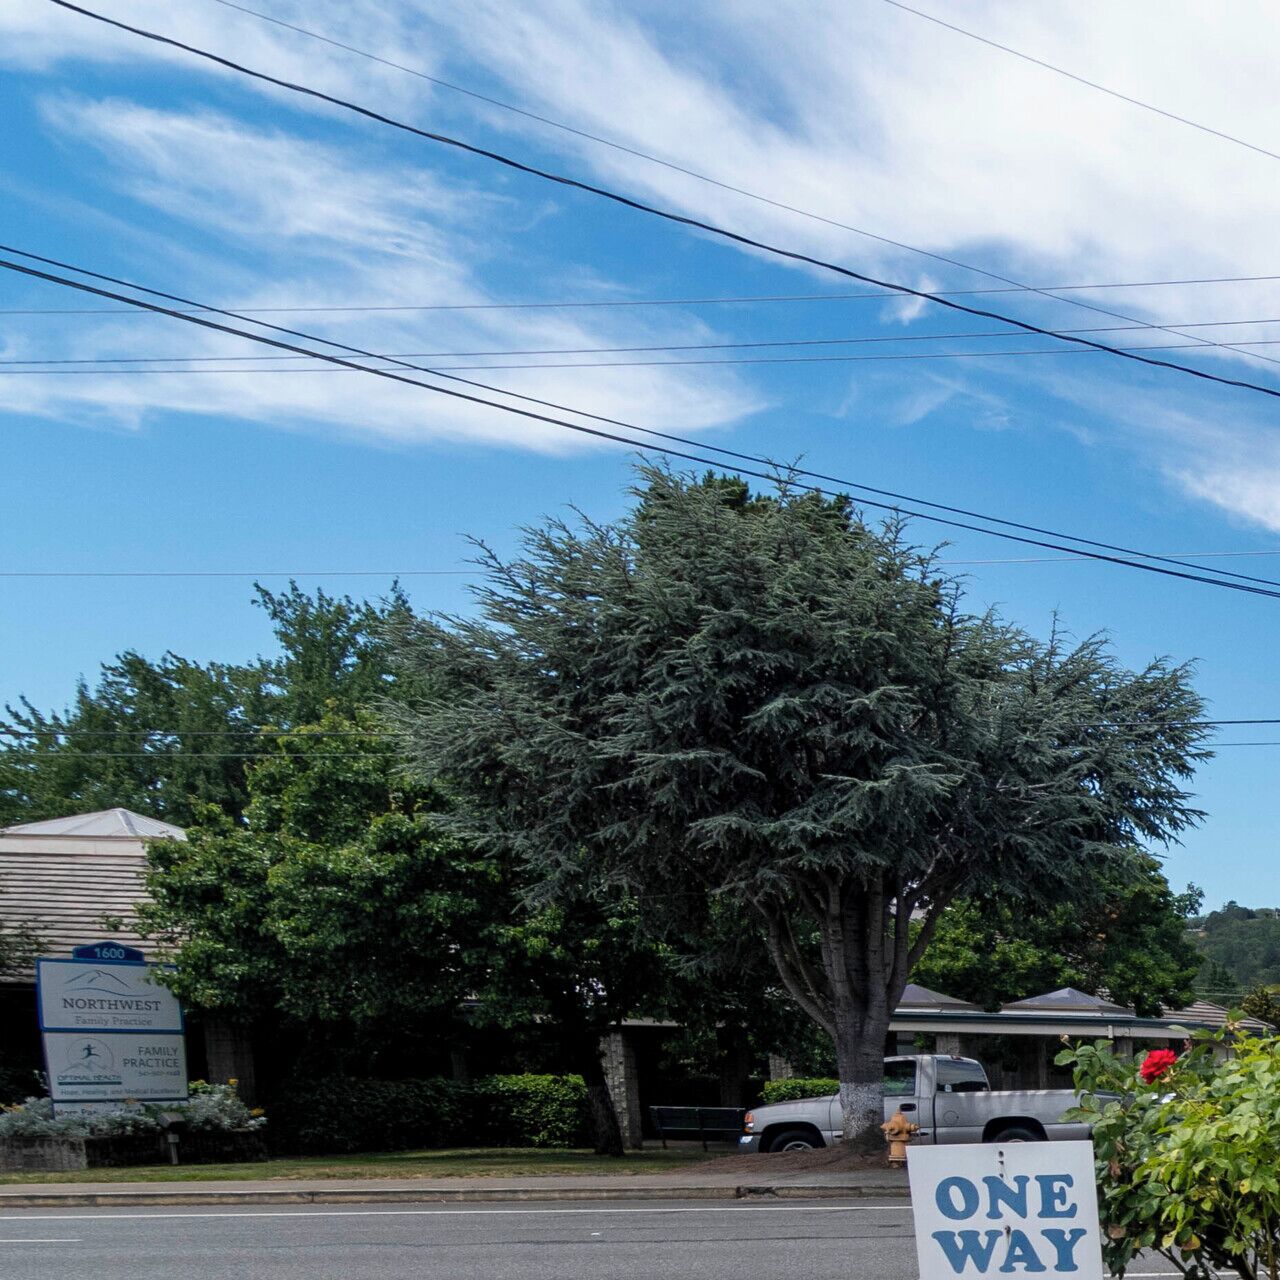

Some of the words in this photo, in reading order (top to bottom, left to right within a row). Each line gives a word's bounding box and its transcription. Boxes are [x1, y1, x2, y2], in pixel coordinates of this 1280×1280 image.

[95, 948, 125, 959] 1600
[63, 998, 161, 1011] NORTHWEST
[75, 1016, 109, 1026] Family
[112, 1016, 153, 1026] Practice
[138, 1046, 179, 1057] FAMILY
[122, 1058, 180, 1068] PRACTICE
[935, 1173, 1078, 1221] ONE
[931, 1228, 1087, 1274] WAY
